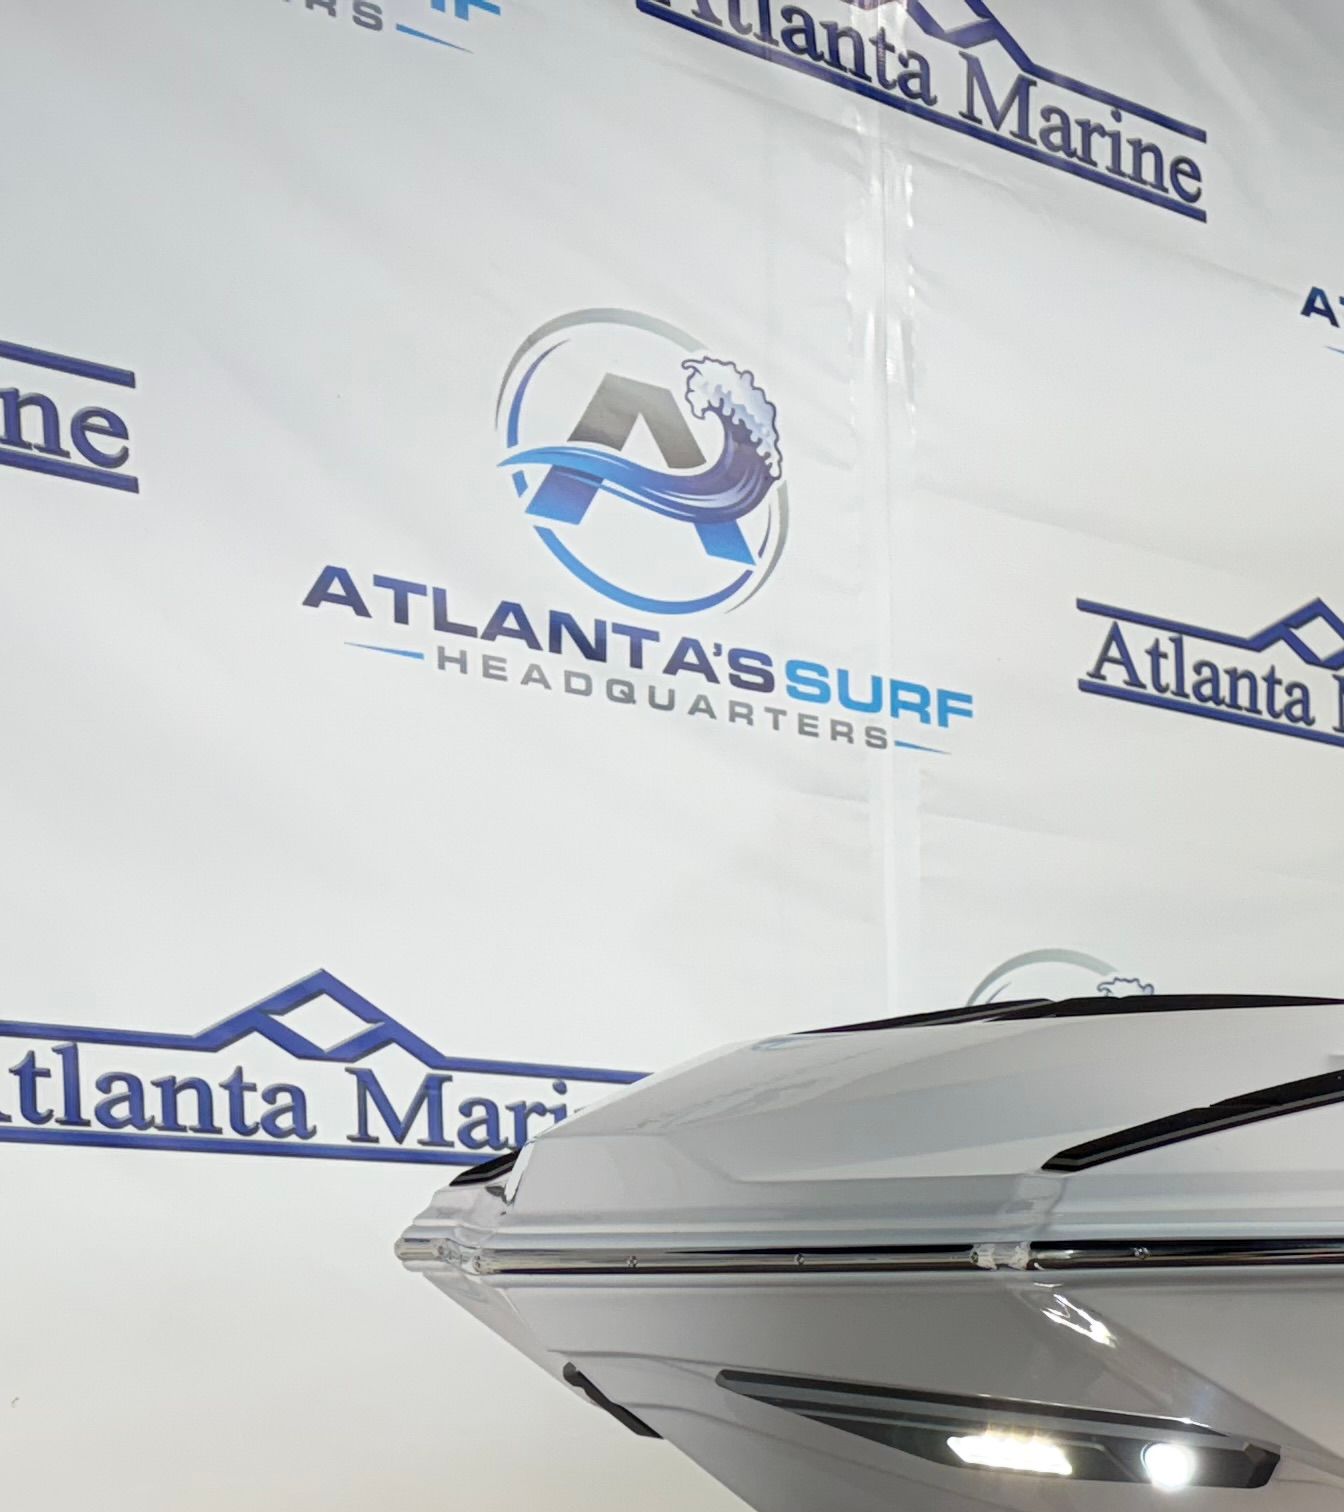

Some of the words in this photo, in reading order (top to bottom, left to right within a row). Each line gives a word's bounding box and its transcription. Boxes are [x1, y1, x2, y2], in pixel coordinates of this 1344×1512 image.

[959, 50, 1202, 203] Marine
[436, 645, 889, 751] HEADQUARTERS
[1086, 620, 1317, 727] Atlanta
[0, 1042, 316, 1140] tlanta
